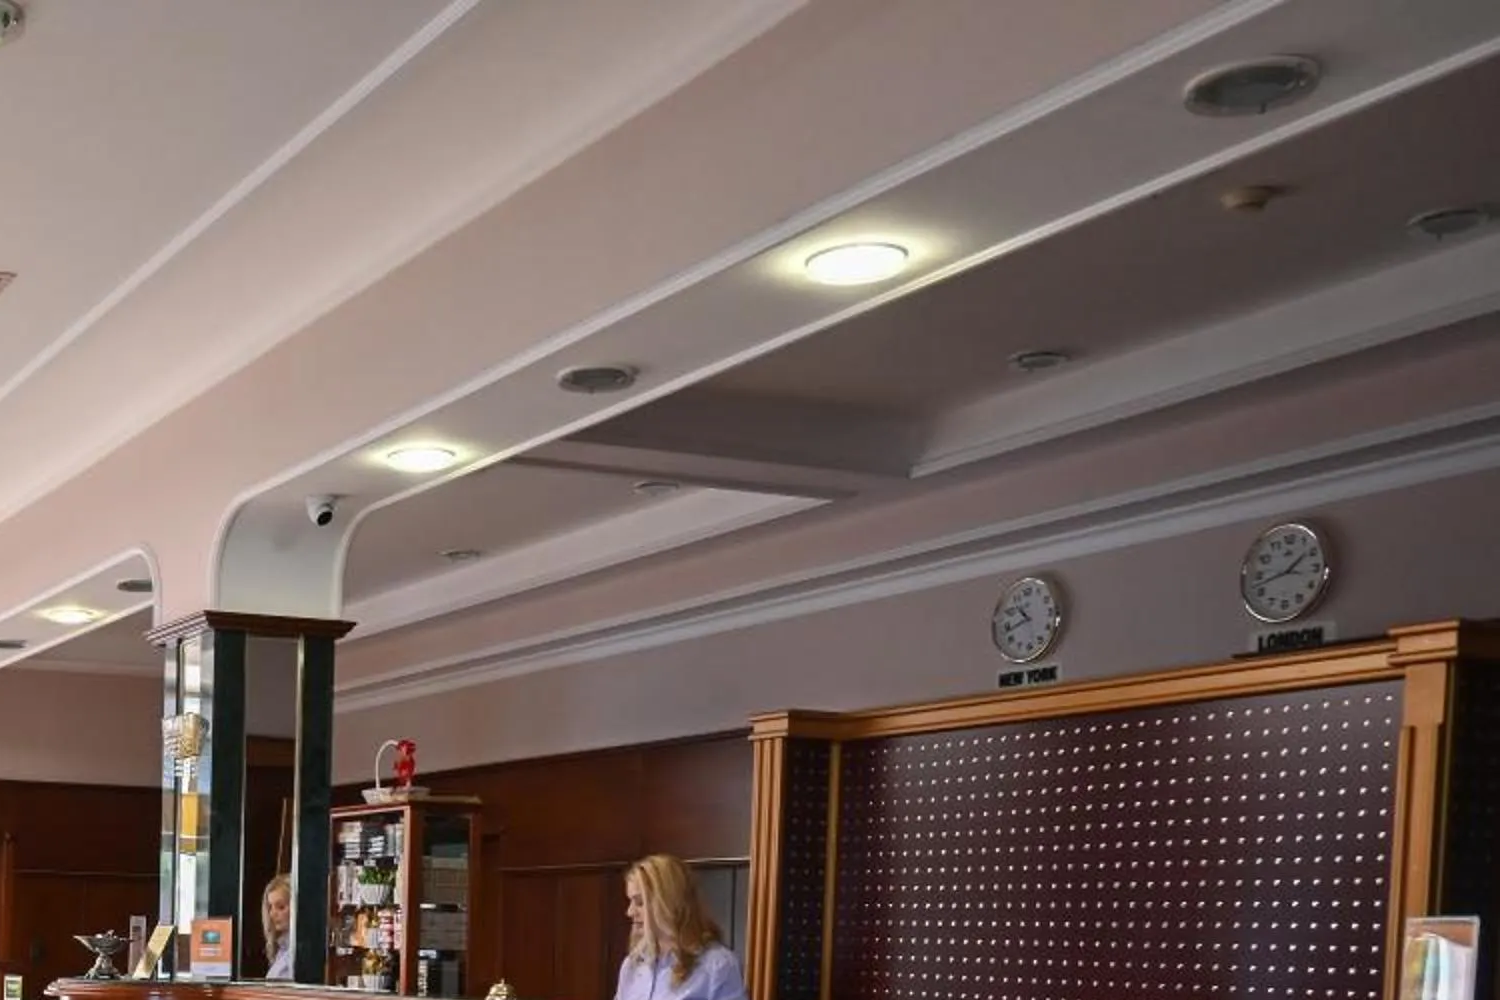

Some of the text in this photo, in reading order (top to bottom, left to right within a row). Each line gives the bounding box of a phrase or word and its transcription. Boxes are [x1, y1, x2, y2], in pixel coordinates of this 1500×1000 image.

[1257, 626, 1324, 652] LONDON
[998, 665, 1057, 688] NEW YORK
